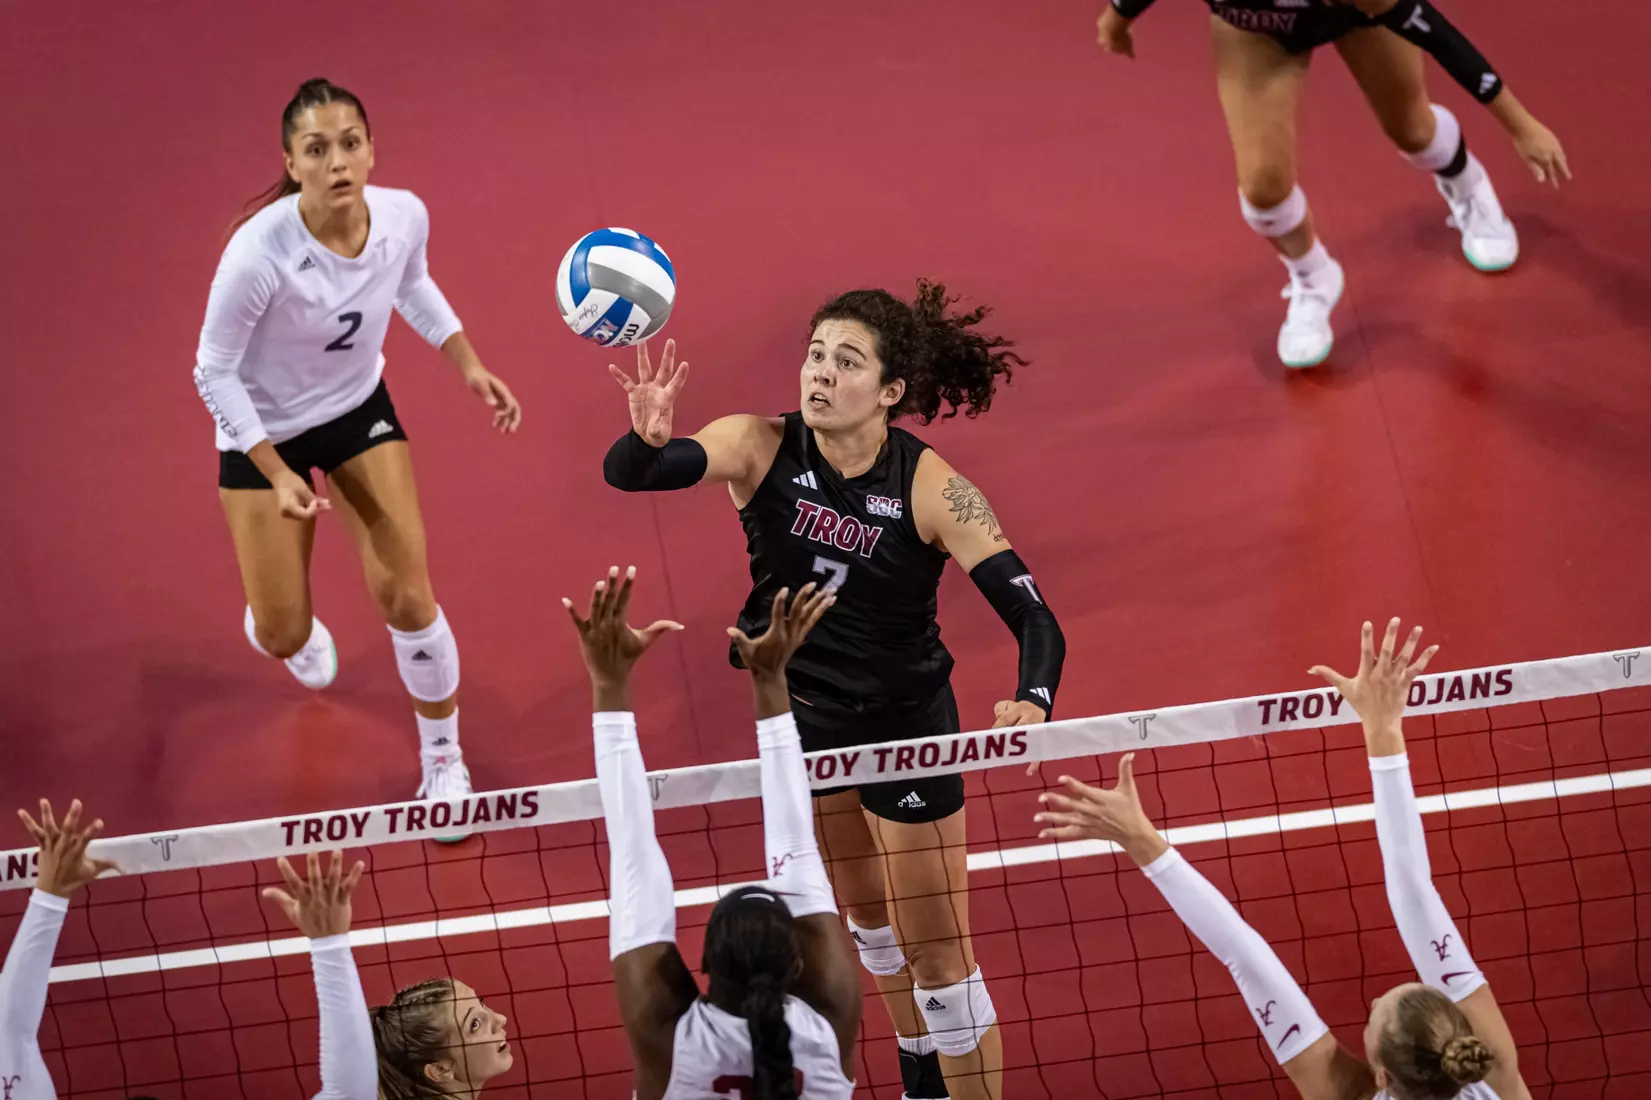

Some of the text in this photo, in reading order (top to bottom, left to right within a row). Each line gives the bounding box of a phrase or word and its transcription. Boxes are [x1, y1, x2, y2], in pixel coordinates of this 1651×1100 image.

[324, 311, 363, 352] 2
[790, 498, 883, 558] TROY
[866, 494, 902, 519] SBC
[812, 554, 849, 593] 7
[1257, 669, 1513, 726] TROY OJANS
[804, 731, 1027, 781] OY TROJANS
[281, 791, 539, 846] TROY TROJANS
